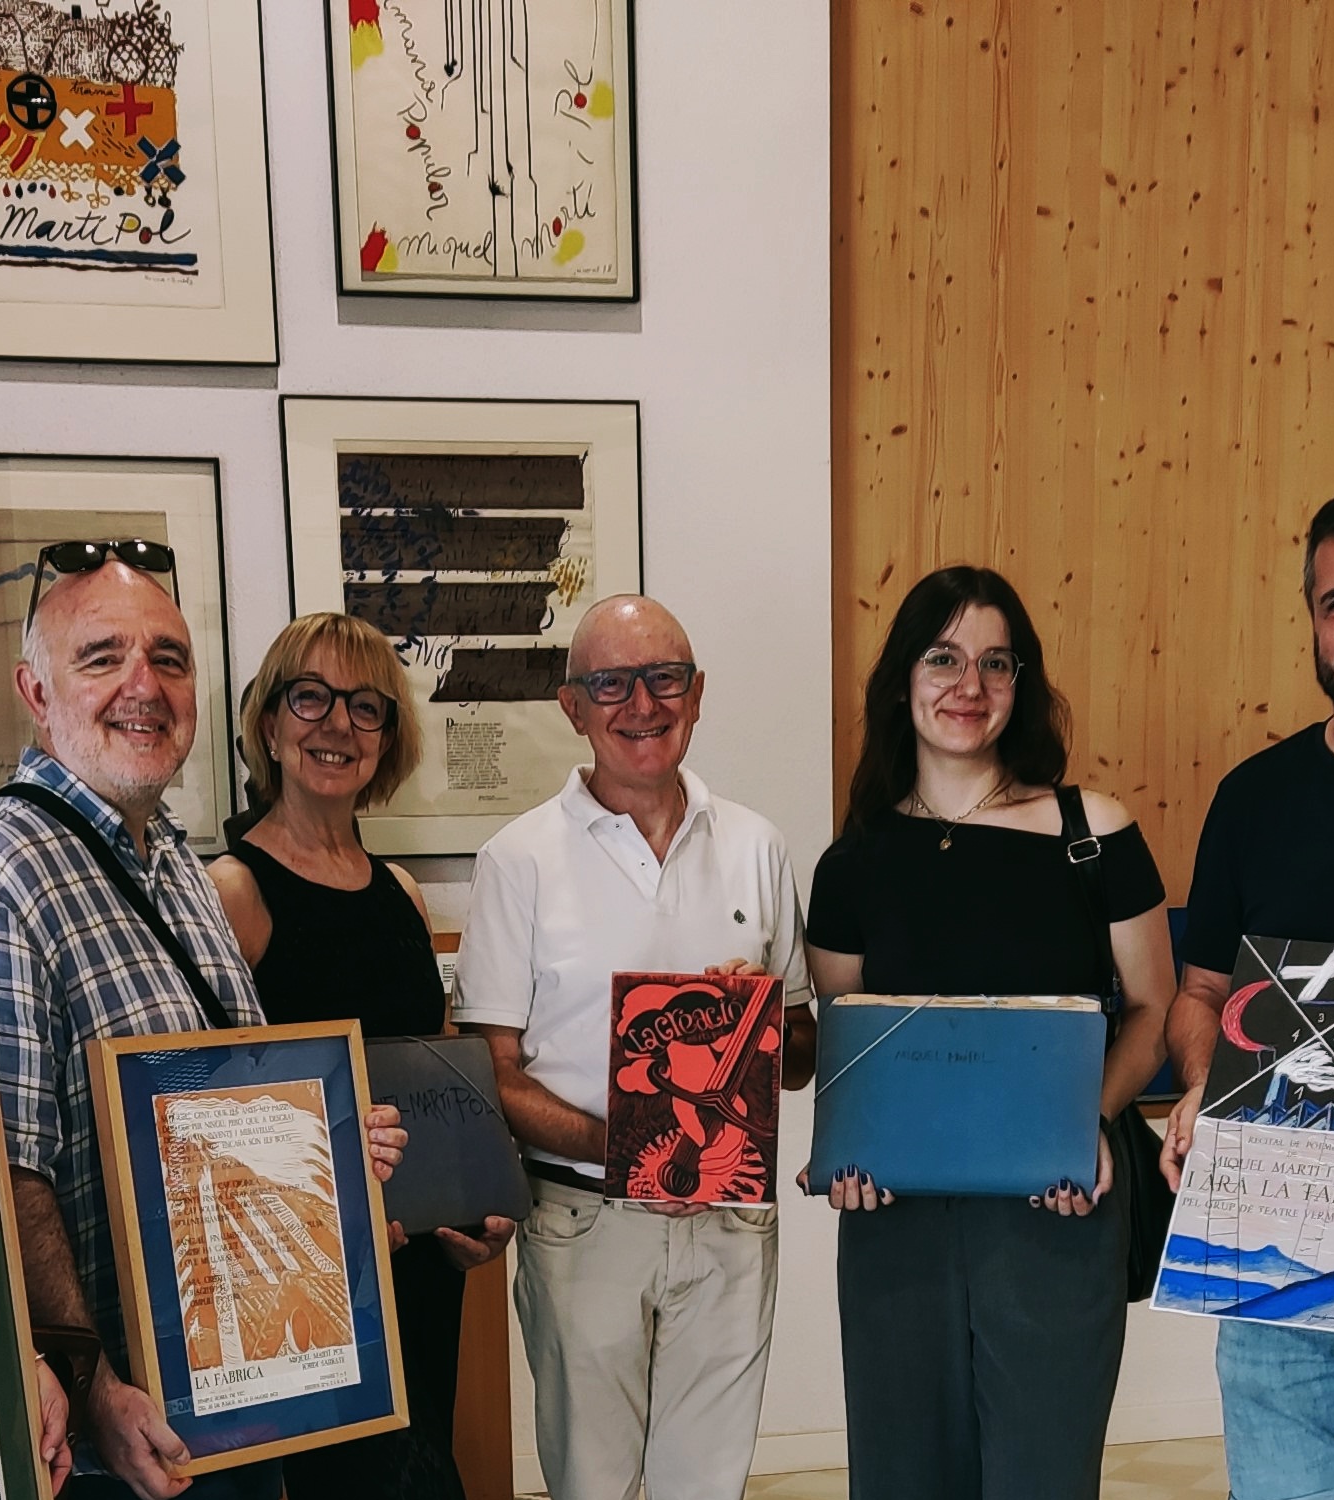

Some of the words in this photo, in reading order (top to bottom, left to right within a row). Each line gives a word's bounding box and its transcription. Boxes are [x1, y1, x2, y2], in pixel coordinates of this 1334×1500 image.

[114, 207, 192, 244] Pol
[1211, 1155, 1265, 1171] MIQUEL
[1186, 1170, 1196, 1188] I
[1261, 1179, 1291, 1199] LA
[1181, 1197, 1202, 1207] PEL
[1205, 1198, 1236, 1211] GRUP
[1240, 1203, 1254, 1213] DE
[1258, 1205, 1299, 1218] TEATRE
[195, 1375, 211, 1391] LA
